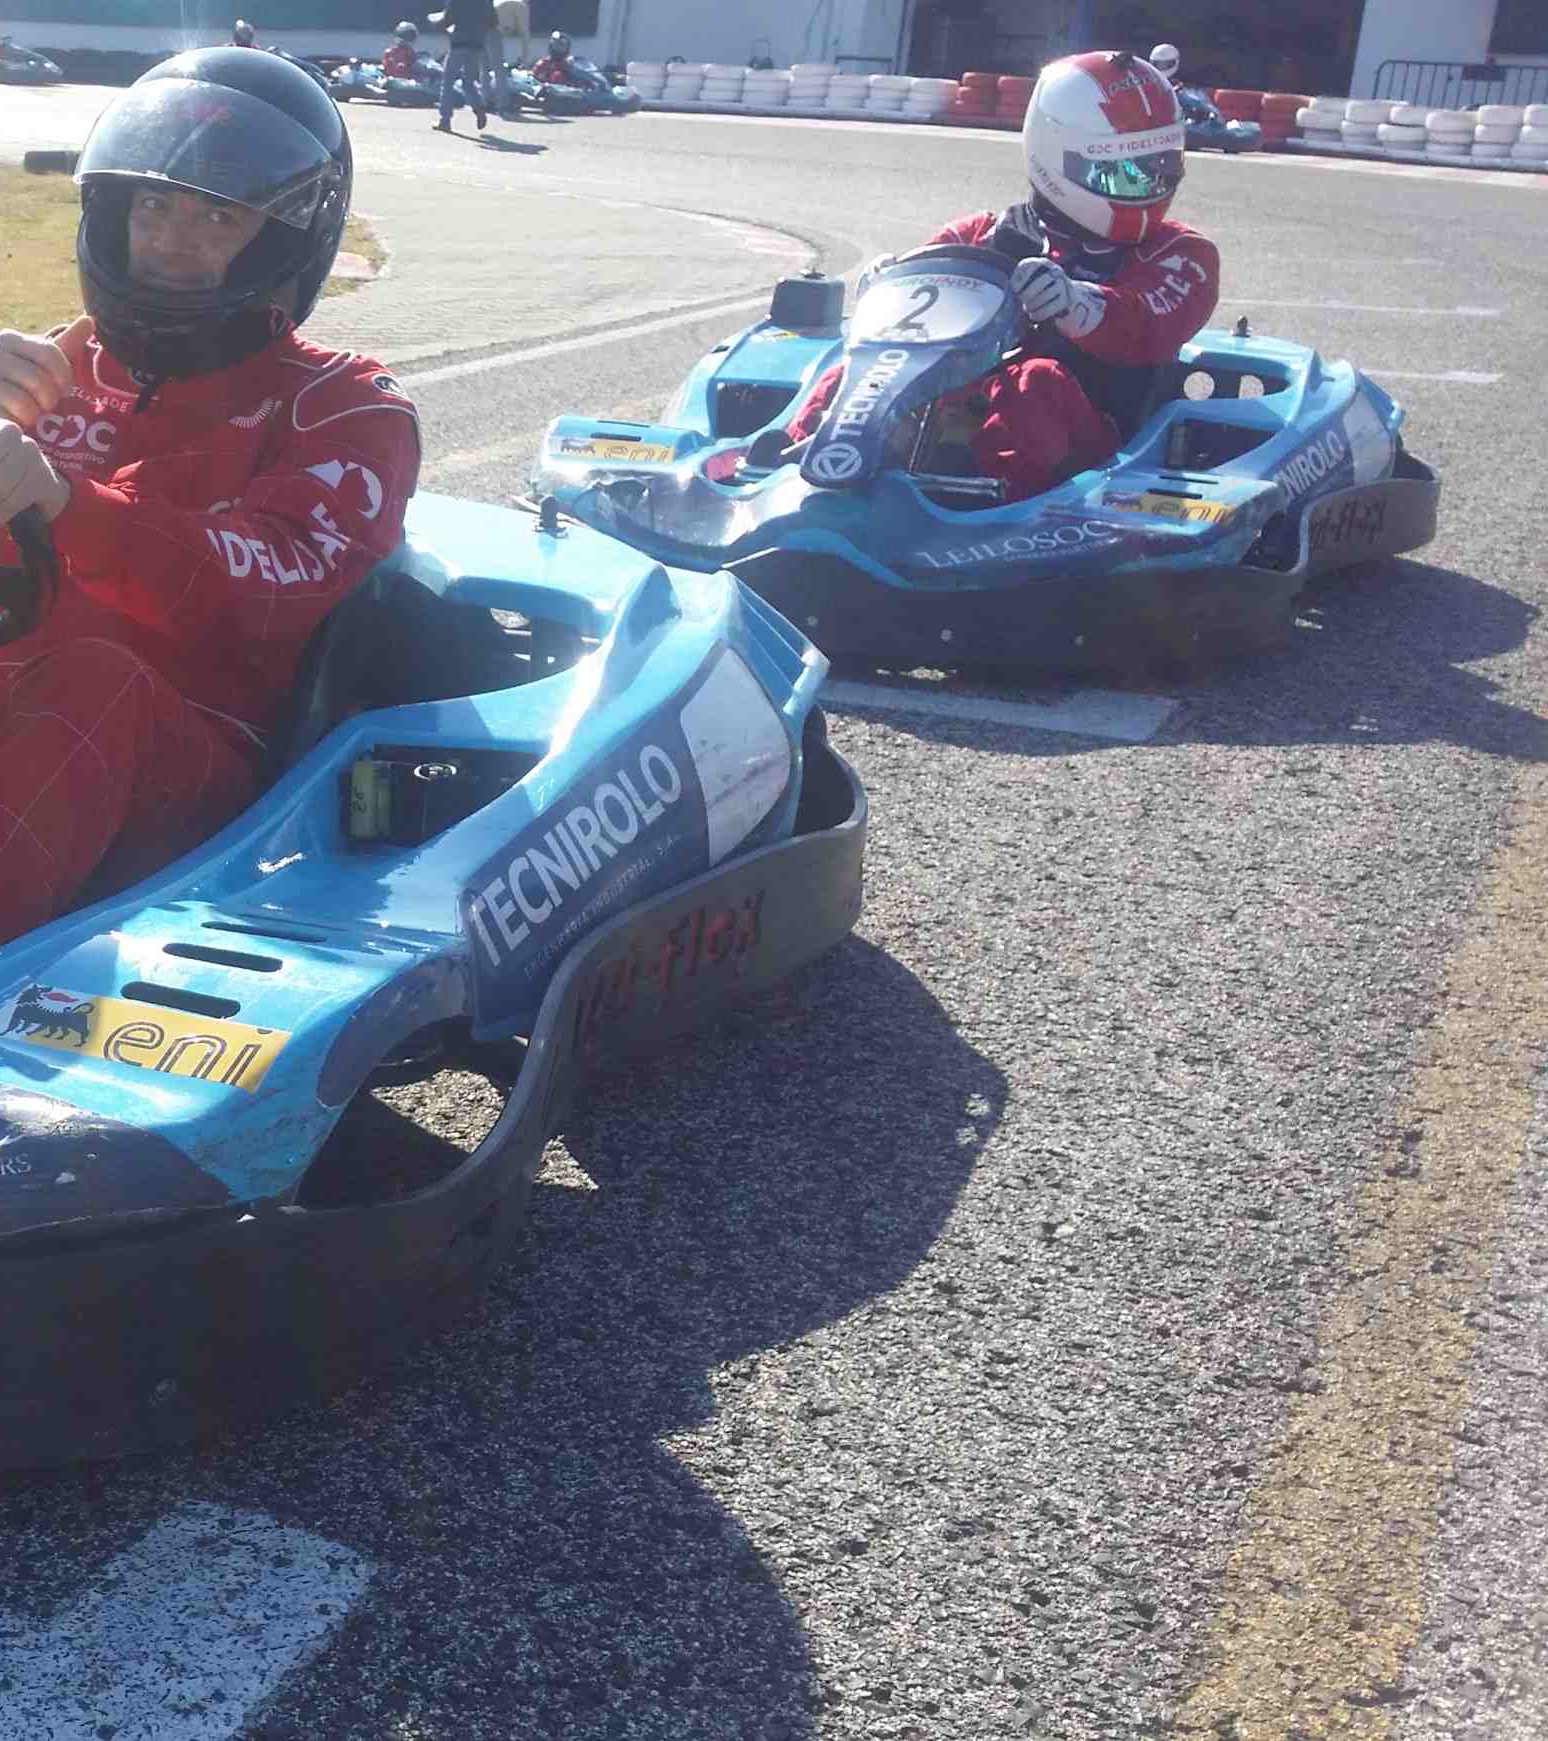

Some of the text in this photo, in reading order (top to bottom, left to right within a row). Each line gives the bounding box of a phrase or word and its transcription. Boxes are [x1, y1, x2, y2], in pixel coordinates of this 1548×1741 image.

[894, 284, 940, 332] 2
[468, 744, 682, 967] TECNIROLO
[103, 1021, 272, 1088] eni
